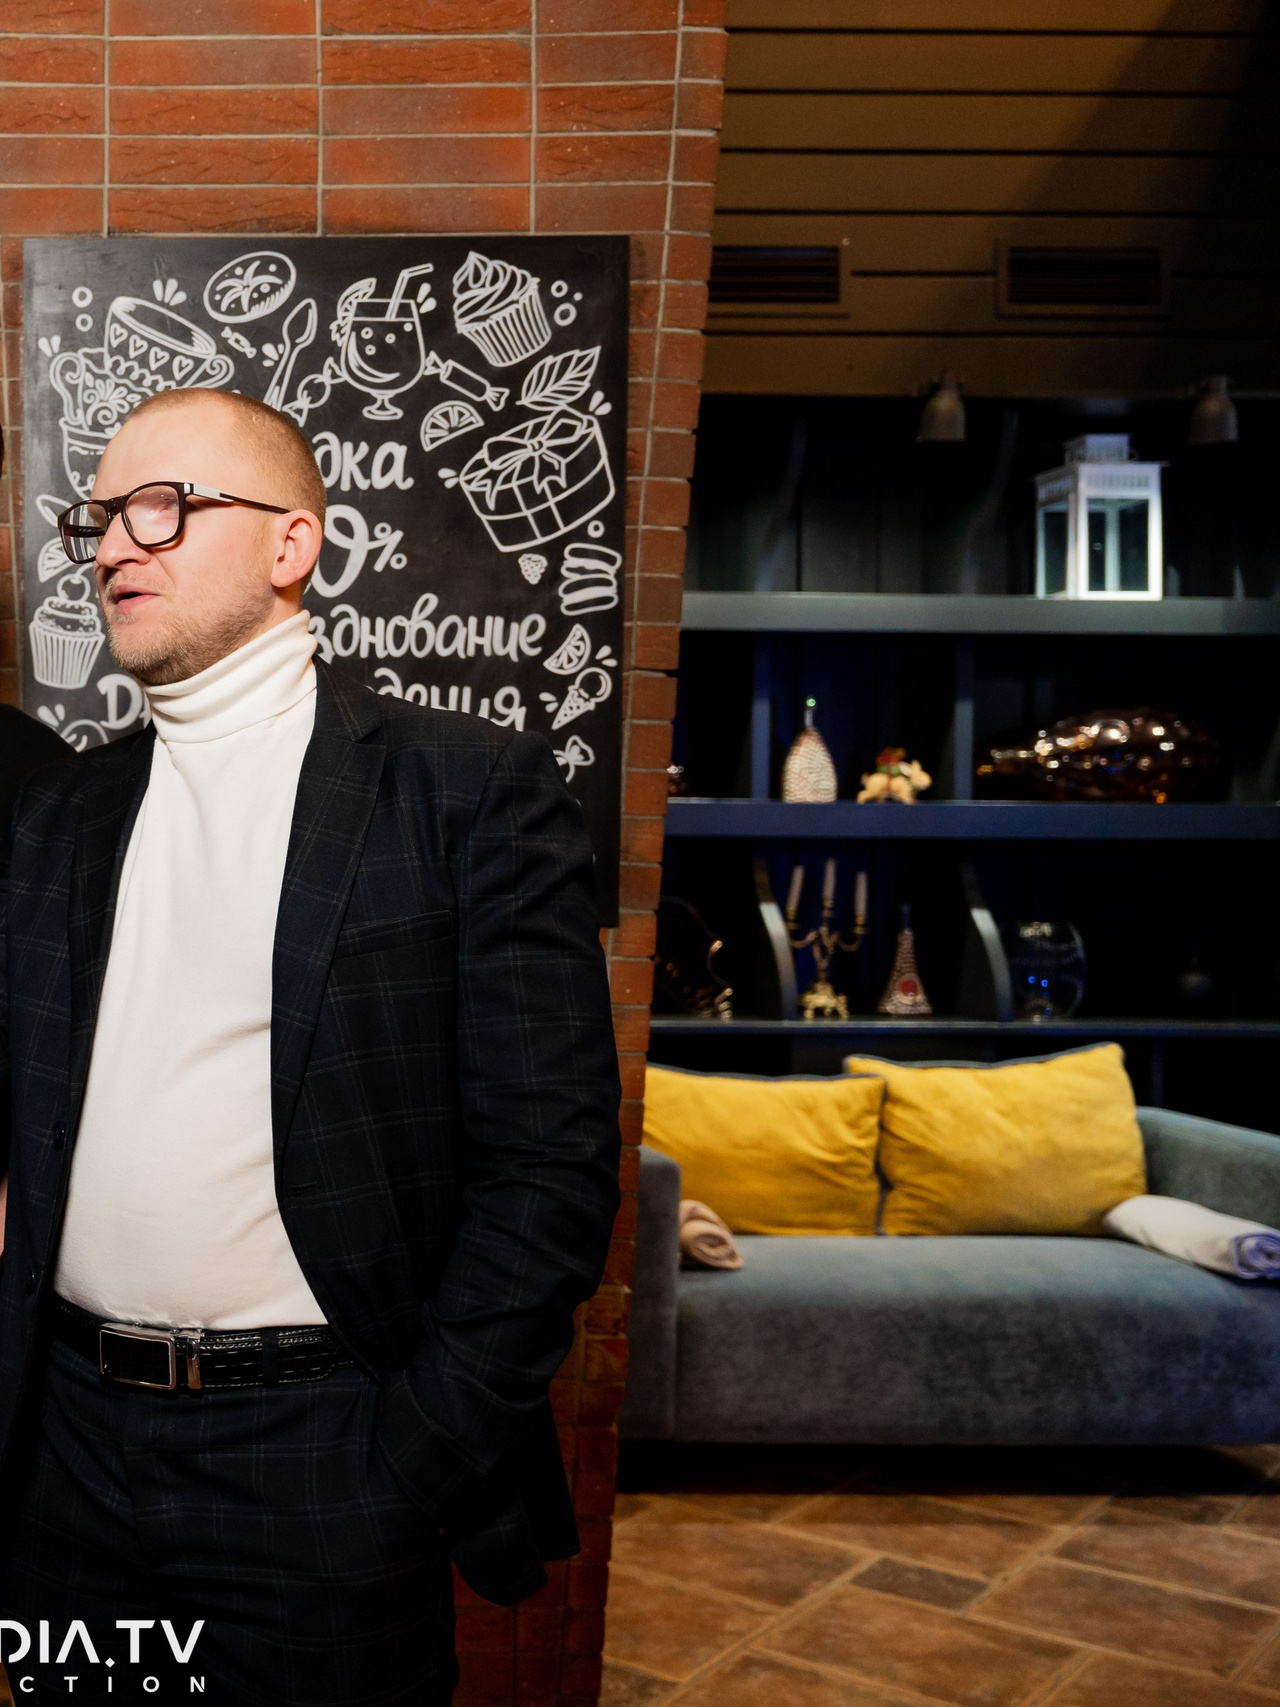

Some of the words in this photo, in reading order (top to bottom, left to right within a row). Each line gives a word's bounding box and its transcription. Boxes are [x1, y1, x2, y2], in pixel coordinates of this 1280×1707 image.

[312, 431, 415, 492] дка
[310, 504, 408, 598] 0%
[308, 592, 547, 663] зднование
